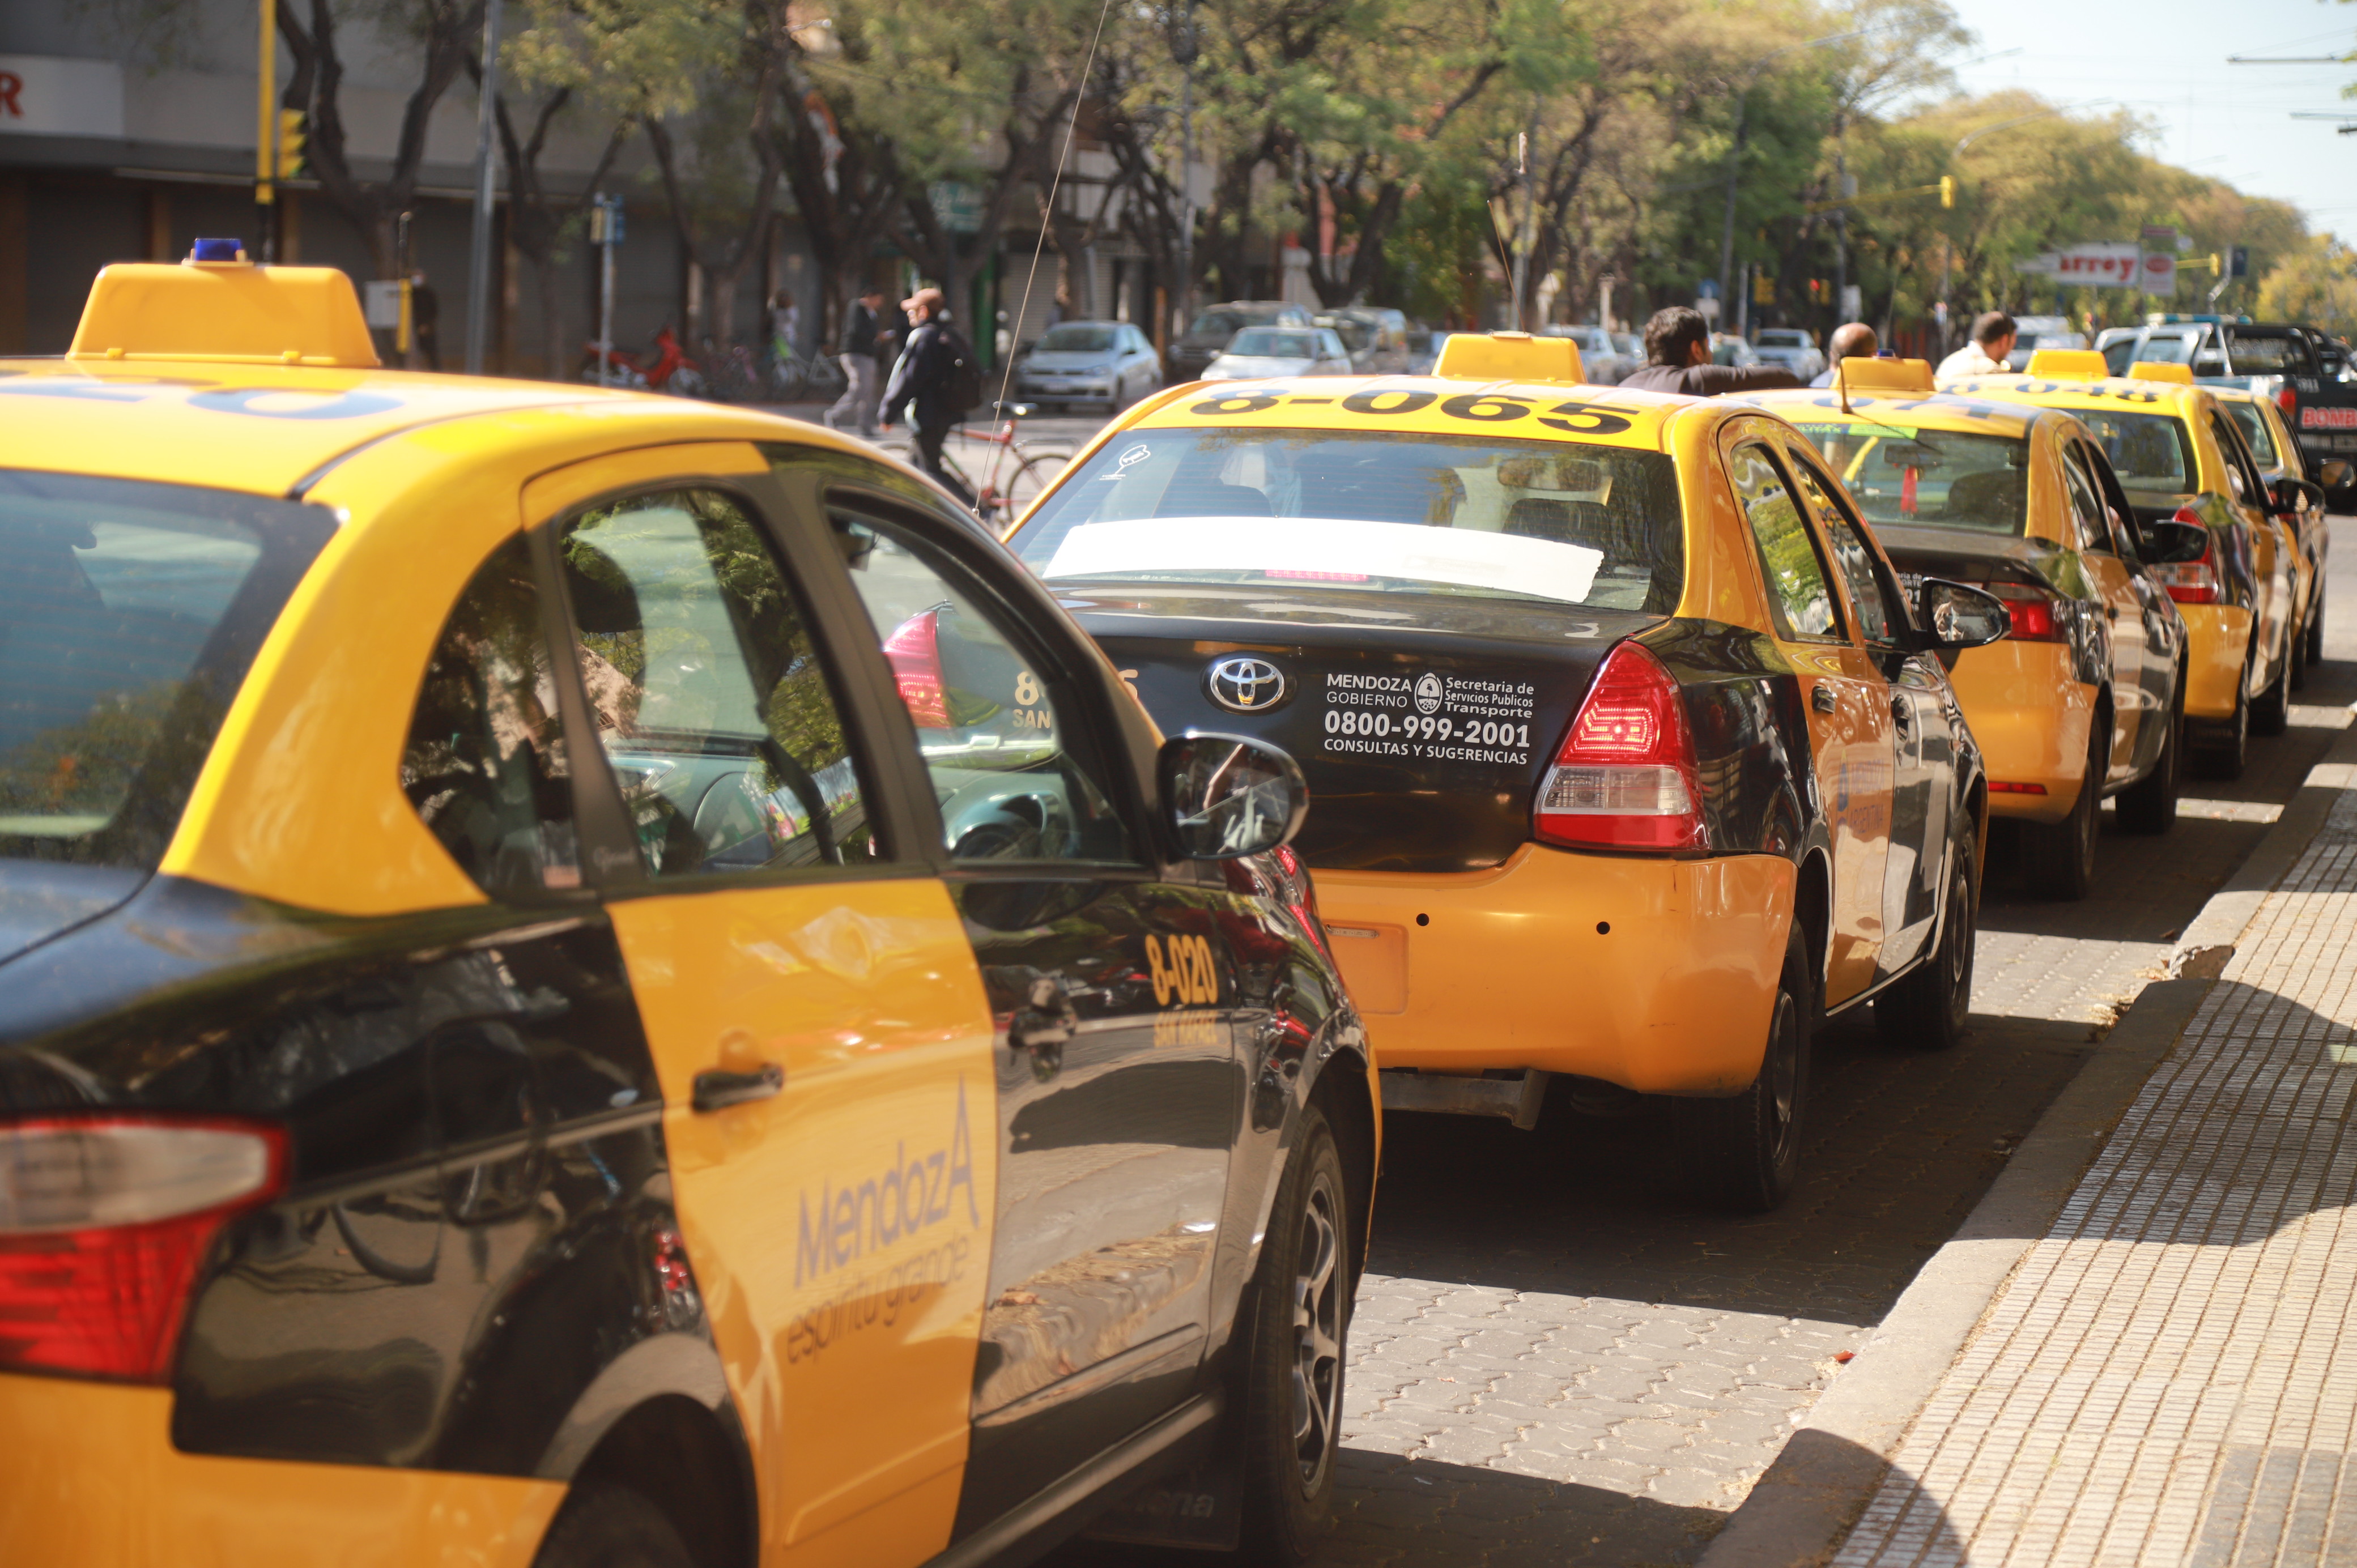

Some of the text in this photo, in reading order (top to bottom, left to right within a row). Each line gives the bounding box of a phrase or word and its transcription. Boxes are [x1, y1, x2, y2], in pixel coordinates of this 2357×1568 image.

[1190, 389, 1640, 435] 8-065
[1327, 673, 1412, 692] MENDOZA
[1446, 677, 1534, 695] Secretaria de
[1327, 691, 1408, 708] GOBIERNO
[1445, 689, 1488, 704] Servicios
[1444, 701, 1533, 718] Transporte
[1325, 710, 1530, 748] 0800-999-2001
[1324, 739, 1528, 765] CONSULTAS Y SUGERENCIAS
[1145, 934, 1218, 1006] 8-020
[883, 1226, 969, 1328] grande
